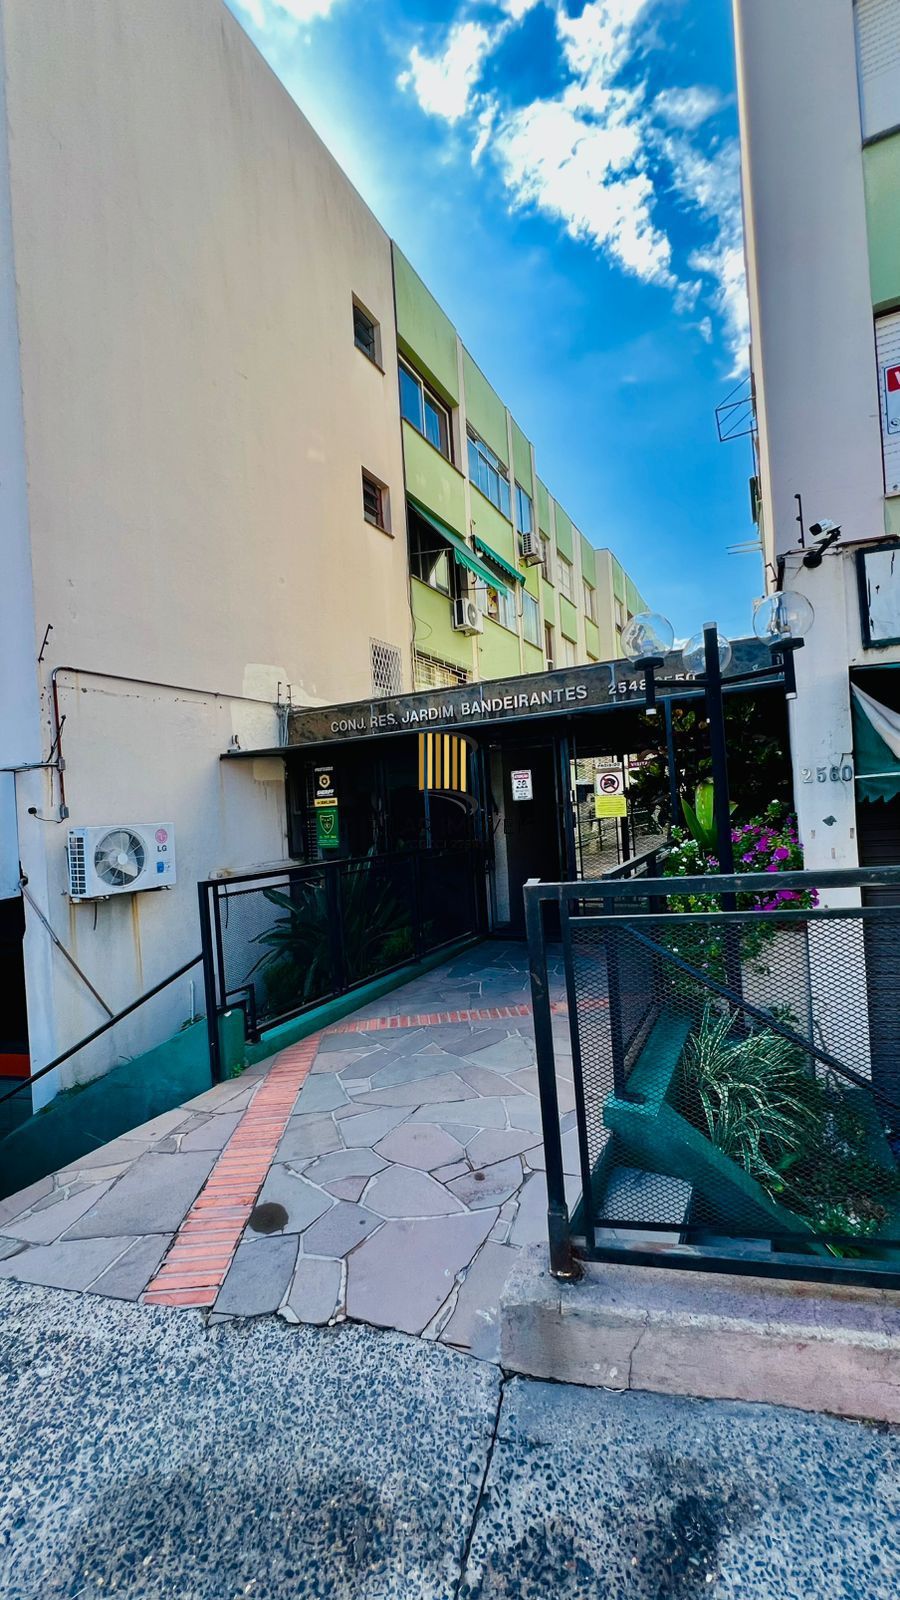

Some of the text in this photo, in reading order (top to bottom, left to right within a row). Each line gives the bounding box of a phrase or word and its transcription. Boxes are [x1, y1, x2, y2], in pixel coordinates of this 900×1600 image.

[330, 717, 366, 733] CONJ.
[370, 713, 398, 729] RES.
[402, 703, 454, 724] JARDIM
[461, 684, 588, 715] BANDEIRANTES
[607, 679, 646, 695] 2548
[801, 764, 853, 784] 2560
[157, 845, 168, 853] LG
